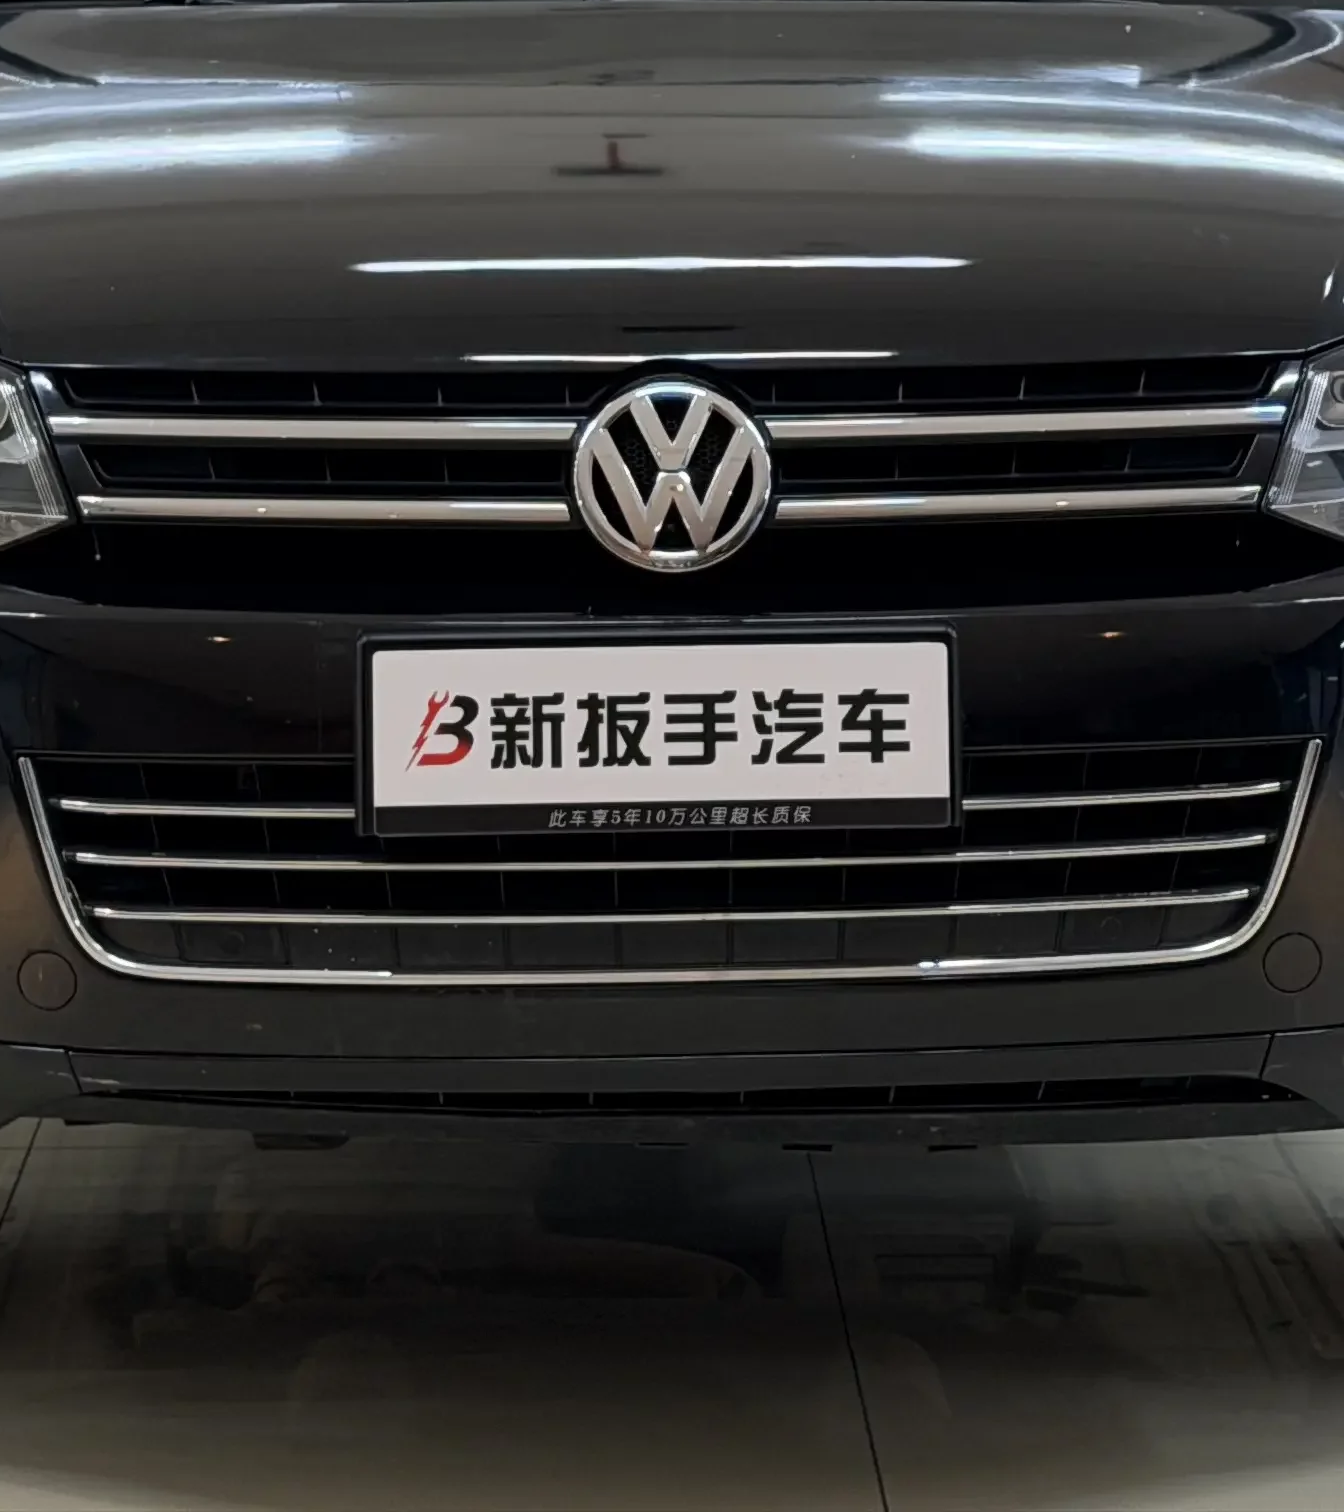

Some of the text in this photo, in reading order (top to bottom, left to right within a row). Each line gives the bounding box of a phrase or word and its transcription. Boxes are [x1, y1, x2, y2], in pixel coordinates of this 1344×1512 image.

[489, 688, 911, 769] 新扳手汽车
[548, 805, 813, 829] 此车享5年10万公里超长质保
